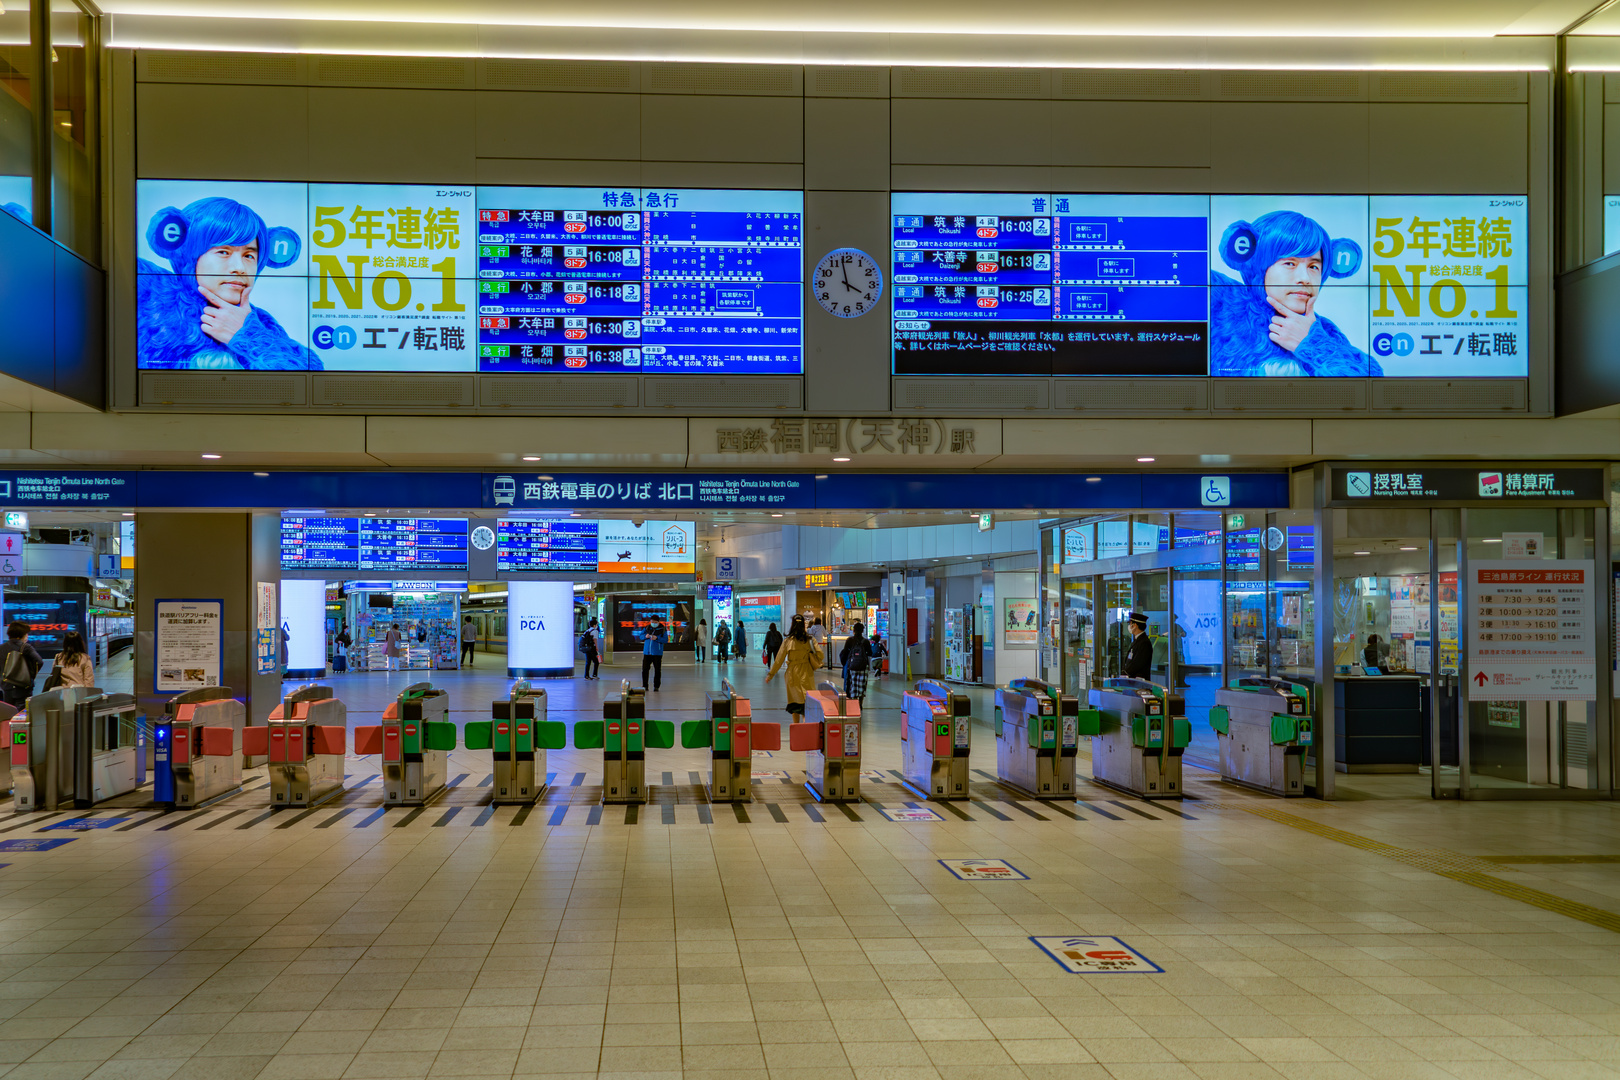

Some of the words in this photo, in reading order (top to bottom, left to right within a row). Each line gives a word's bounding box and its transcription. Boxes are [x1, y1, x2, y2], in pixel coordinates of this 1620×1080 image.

[602, 191, 679, 208] 特急・急行
[1031, 197, 1069, 213] 普通
[482, 211, 506, 221] 特急
[518, 211, 554, 222] 大牟田
[588, 216, 621, 227] 16:00
[628, 215, 635, 224] 3
[934, 216, 965, 227] 筑紫
[312, 204, 460, 250] 5年連続
[897, 217, 920, 227] 普通
[1000, 221, 1032, 232] 16:03
[1039, 220, 1045, 229] 2
[163, 222, 180, 240] e
[1372, 216, 1512, 258] 5年連続
[274, 238, 288, 255] n
[1234, 236, 1250, 254] e
[482, 246, 506, 256] 急行
[520, 247, 553, 258] 花畑
[588, 251, 621, 262] 16:08
[629, 250, 634, 259] 1
[373, 256, 429, 268] 総合満足度
[897, 252, 920, 262] 普通
[932, 251, 967, 263] 大善寺
[1000, 256, 1032, 267] 16:13
[1039, 255, 1045, 264] 2
[1336, 250, 1348, 266] n
[822, 269, 832, 277] 10
[865, 268, 872, 276] 2
[1429, 265, 1482, 277] 総合満足度
[312, 254, 466, 312] No.1
[482, 282, 506, 292] 急行
[520, 282, 553, 293] 小郡
[818, 280, 825, 288] 9
[869, 281, 876, 289] 3
[588, 287, 621, 298] 16:18
[628, 286, 635, 295] 3
[822, 292, 829, 300] 8
[897, 287, 920, 296] 普通
[934, 286, 965, 297] 筑紫
[1039, 290, 1045, 298] 2
[1372, 264, 1517, 318] No.1
[1000, 291, 1032, 302] 16:25
[482, 317, 506, 327] 特急
[518, 318, 554, 329] 大牟田
[588, 322, 621, 333] 16:30
[628, 321, 635, 330] 3
[318, 330, 350, 344] en
[363, 326, 466, 350] エン転職
[894, 342, 1056, 351] 等、詳しくはホームページをご確認ください。
[1376, 338, 1408, 350] en
[1419, 333, 1516, 356] エン転職
[482, 346, 506, 356] 急行
[520, 346, 553, 357] 花畑
[588, 350, 621, 361] 16:38
[629, 349, 634, 358] 1
[716, 418, 976, 454] 西鉄福岡(天神)駅
[1374, 473, 1423, 490] 授乳室
[1506, 473, 1555, 490] 精算所
[523, 482, 651, 500] 西鉄電車のりば
[658, 482, 694, 500] 北口
[108, 556, 115, 569] 1
[721, 558, 732, 570] 3
[1483, 573, 1541, 581] 三池島原ライン
[1545, 572, 1579, 581] 運行状況
[520, 620, 545, 631] PCA
[937, 725, 948, 735] IC
[13, 733, 26, 744] IC
